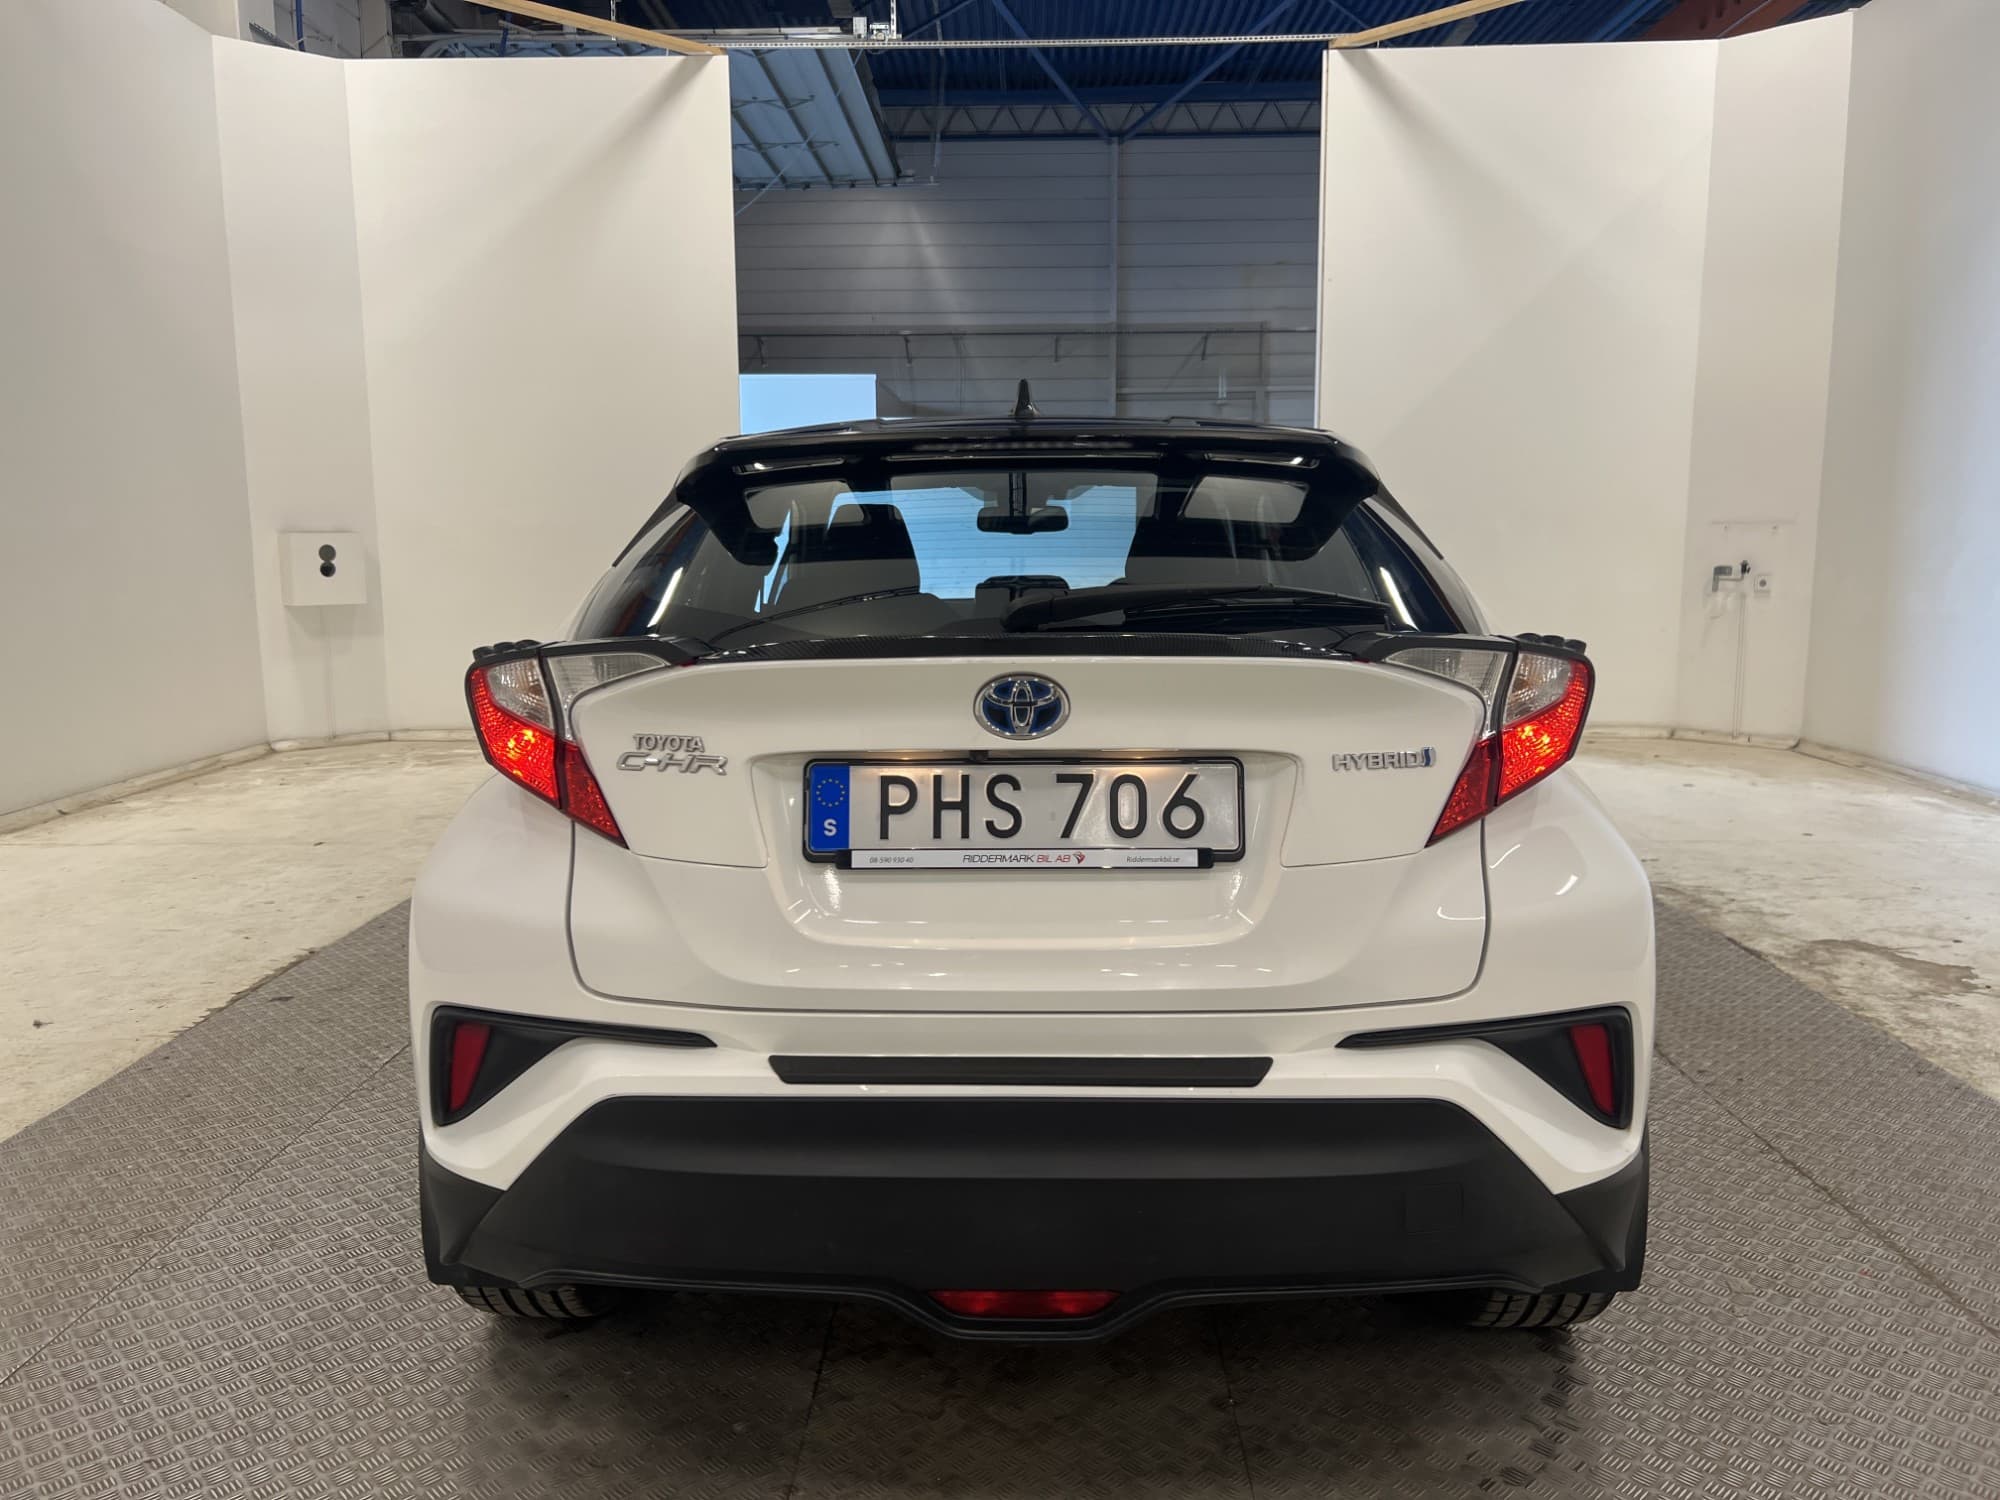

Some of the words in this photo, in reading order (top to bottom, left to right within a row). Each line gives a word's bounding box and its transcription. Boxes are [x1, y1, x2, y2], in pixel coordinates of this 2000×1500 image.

[633, 734, 705, 752] TOYOTA
[617, 752, 728, 775] C-HR
[1332, 751, 1420, 771] HYBRID
[879, 774, 1022, 839] PHS
[1056, 773, 1205, 839] 706
[823, 819, 837, 836] S
[962, 854, 1034, 863] RIDDERMARK
[1036, 854, 1051, 863] BIL
[1055, 854, 1071, 863] AB
